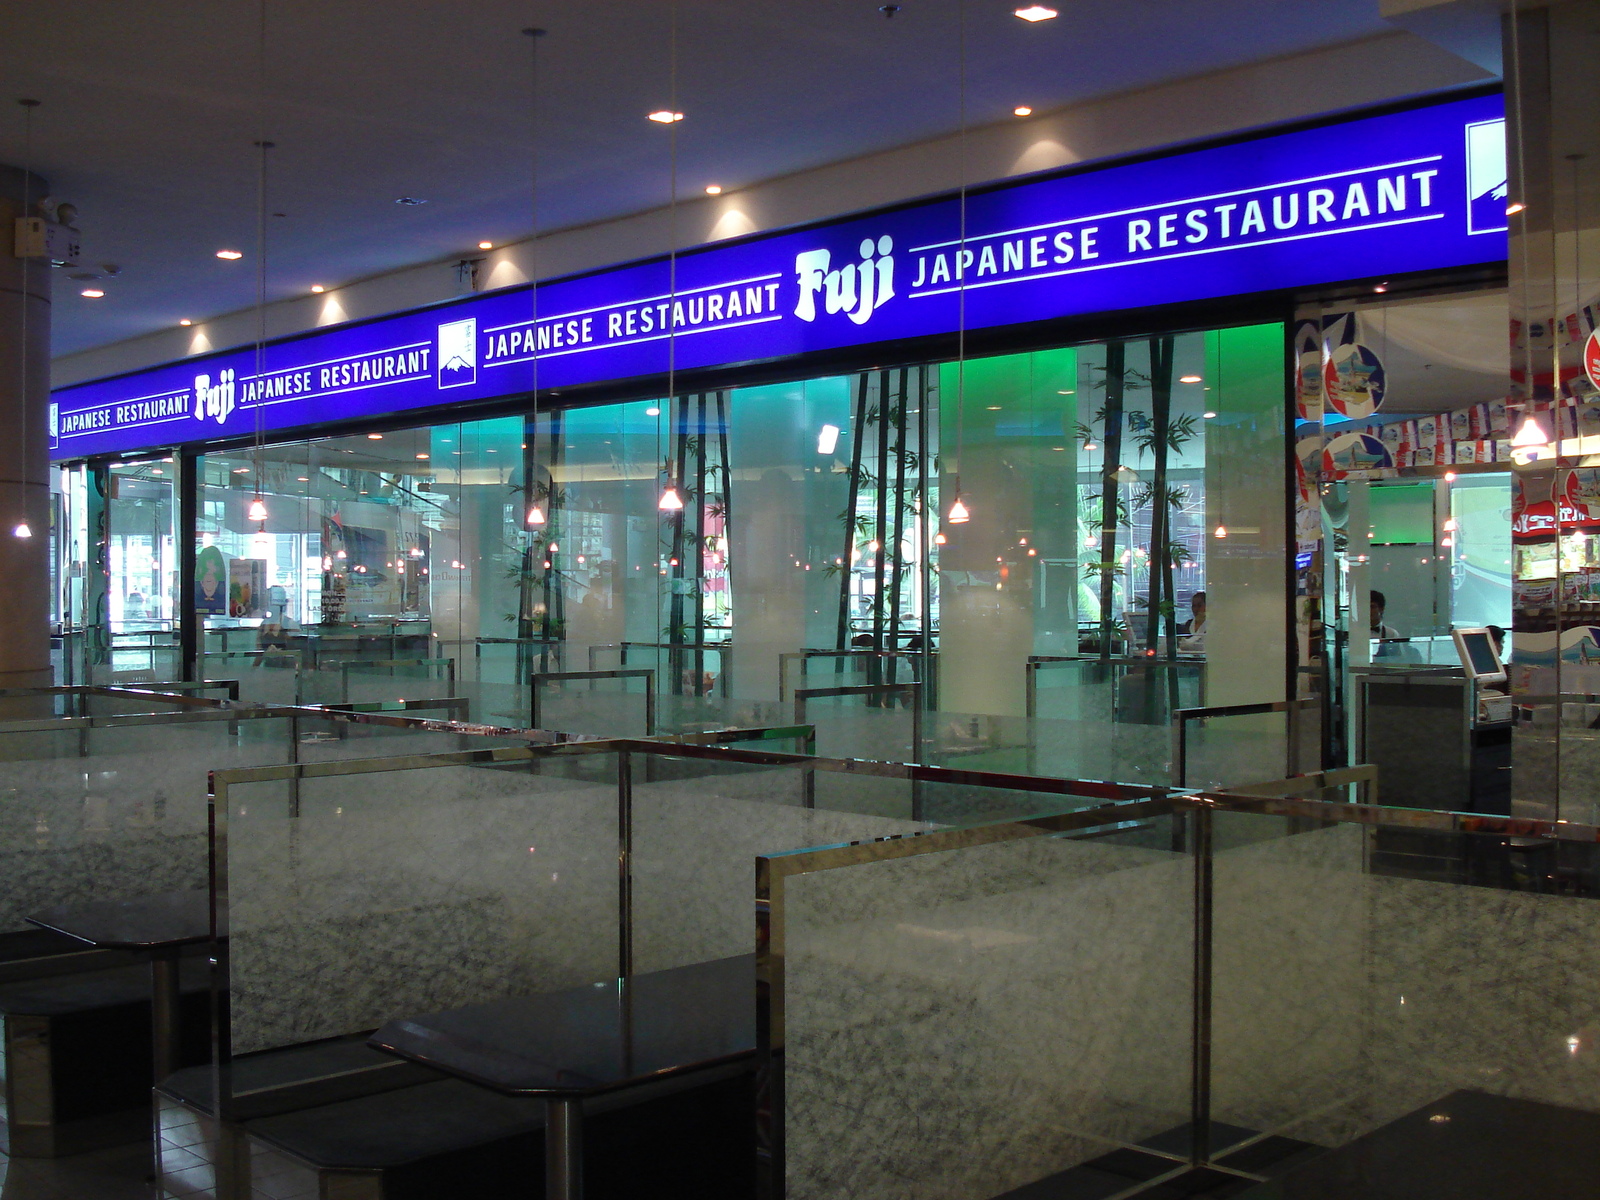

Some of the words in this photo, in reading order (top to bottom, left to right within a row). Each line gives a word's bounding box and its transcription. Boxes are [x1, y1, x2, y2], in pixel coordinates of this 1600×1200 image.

[911, 226, 1099, 288] JAPANESE
[1128, 169, 1438, 253] RESTAURANT
[793, 235, 896, 325] Fuji
[485, 317, 593, 360] JAPANESE
[608, 283, 780, 339] RESTAURANT
[194, 368, 236, 425] Fuji
[240, 371, 312, 403] JAPANESE
[320, 349, 430, 389] RESTAURANT
[61, 409, 111, 434] JAPANESE
[116, 395, 190, 424] RESTAURANT
